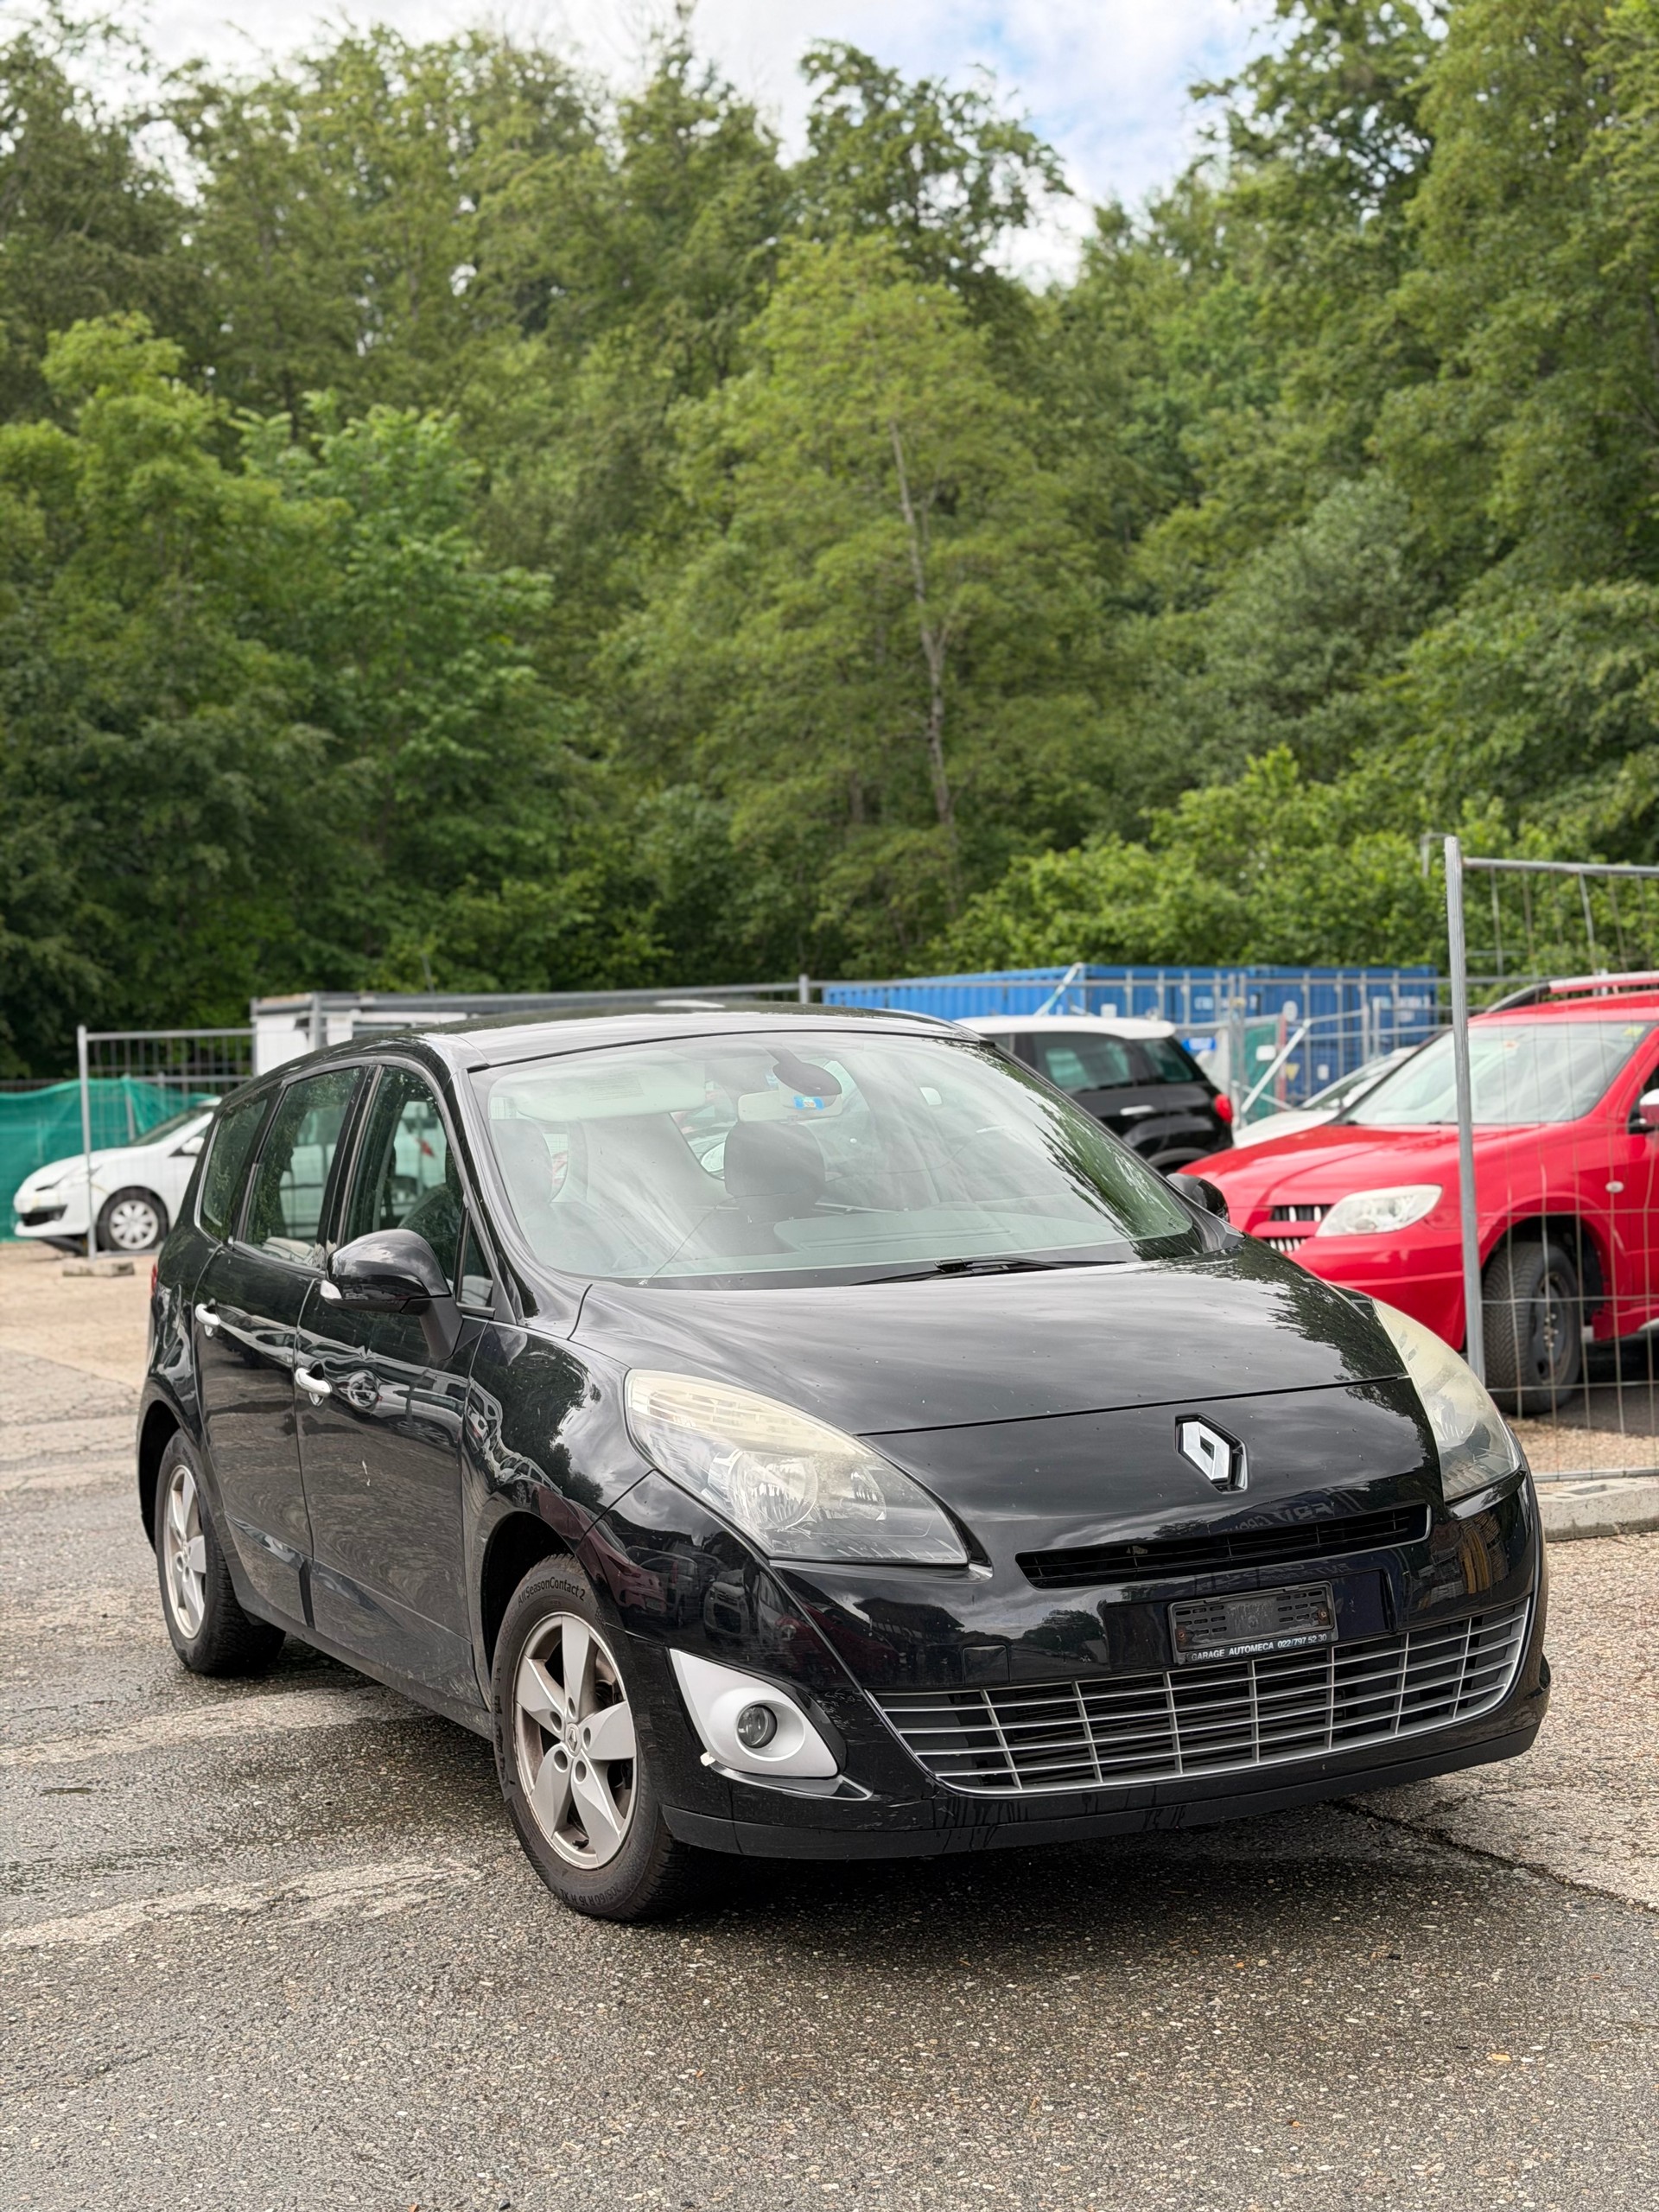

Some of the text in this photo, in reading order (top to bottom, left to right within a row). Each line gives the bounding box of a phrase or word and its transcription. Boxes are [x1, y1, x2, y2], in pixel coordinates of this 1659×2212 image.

[580, 1588, 586, 1602] 2
[1191, 1633, 1327, 1662] GARAGE AUTOMECA 022/797 52 30
